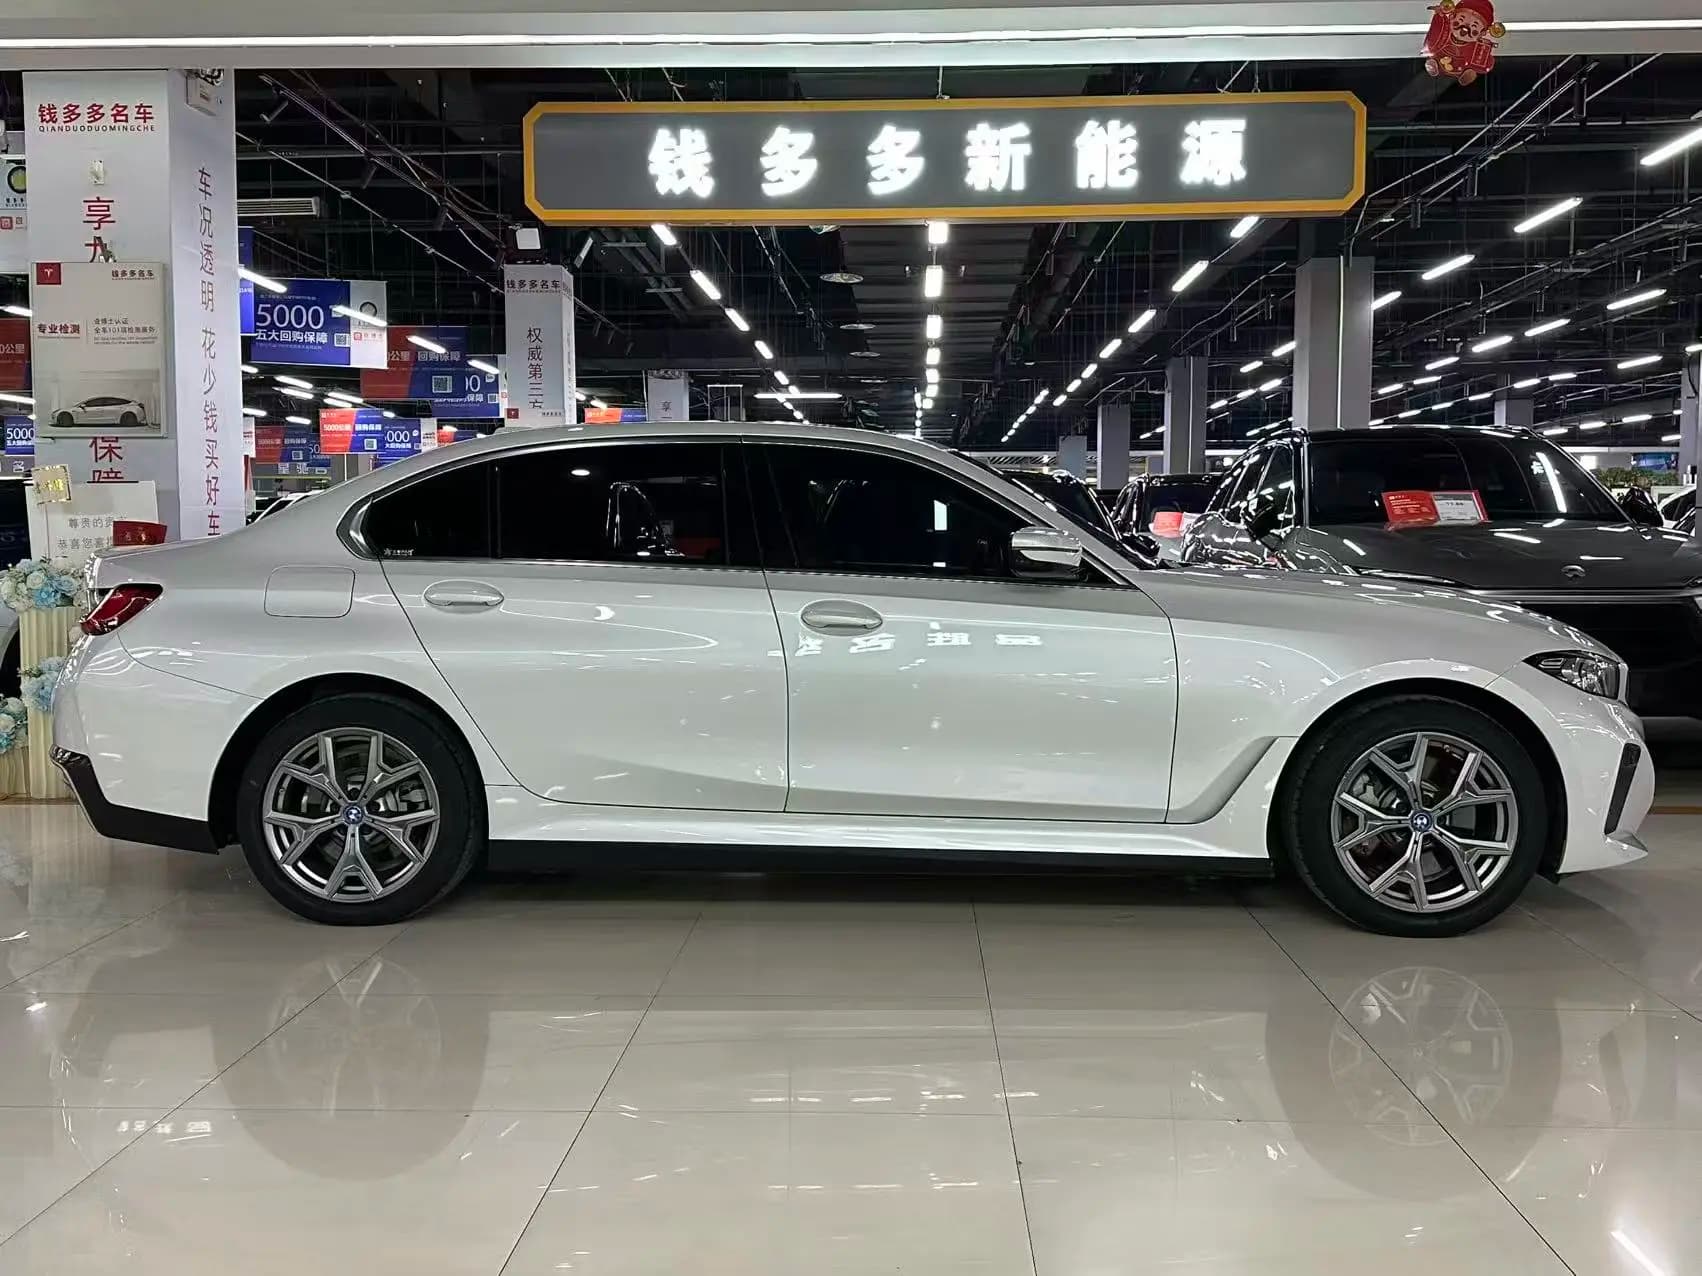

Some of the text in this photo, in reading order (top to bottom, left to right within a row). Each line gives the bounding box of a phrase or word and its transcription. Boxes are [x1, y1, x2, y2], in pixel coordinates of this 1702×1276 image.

[38, 103, 154, 124] 钱多多名车
[648, 118, 1248, 198] 钱多多新能源
[198, 167, 215, 313] 车况透明
[256, 304, 324, 329] 5000
[38, 323, 80, 334] 专业检测
[255, 329, 328, 344] 五大回购保障
[6, 428, 36, 440] 5000
